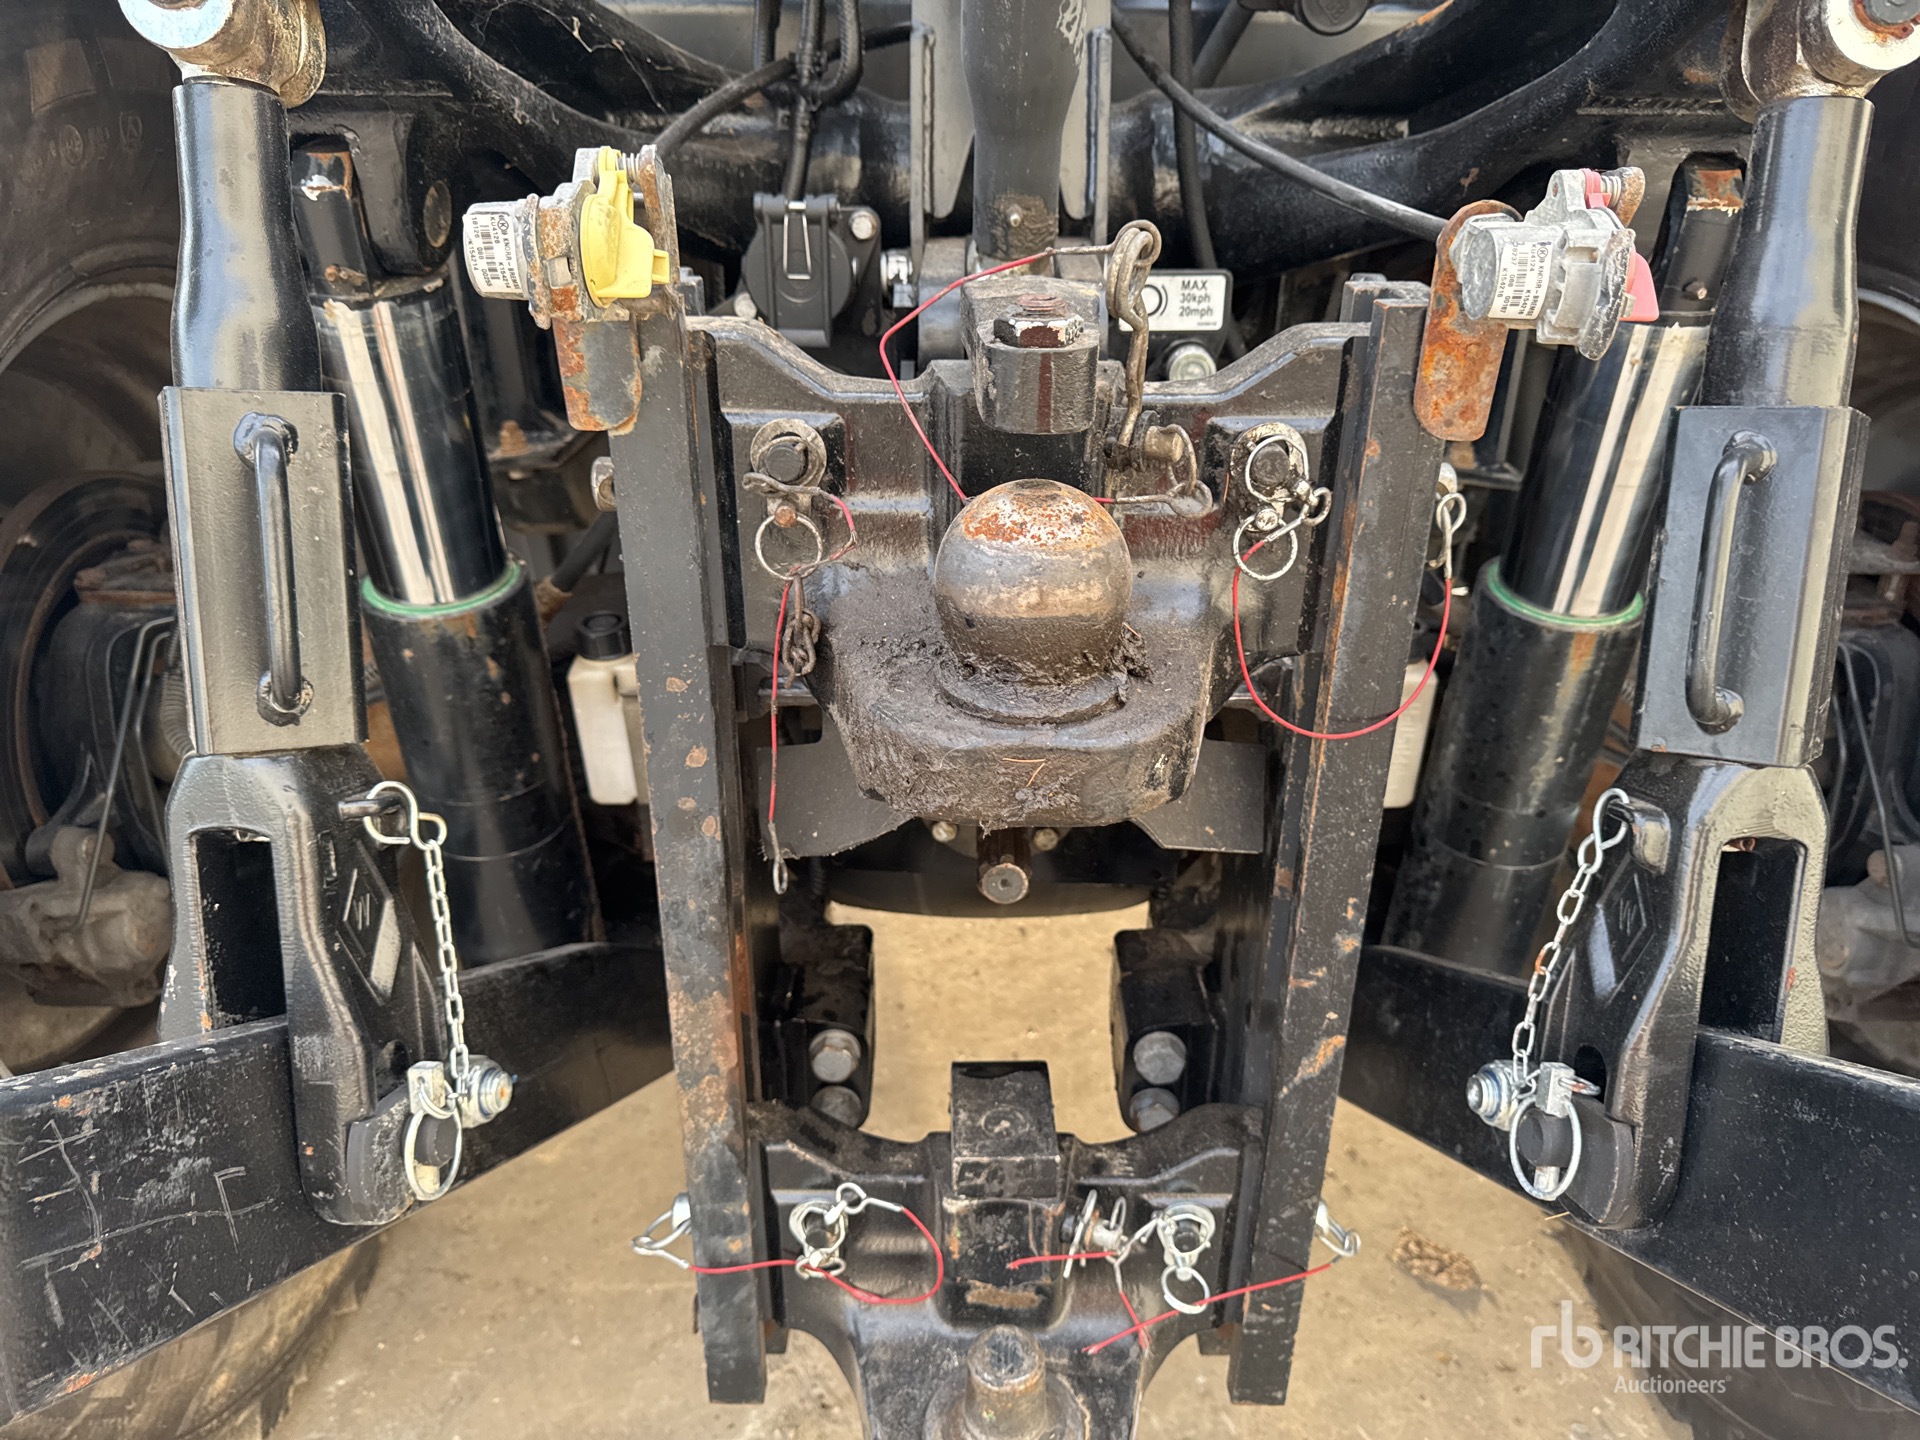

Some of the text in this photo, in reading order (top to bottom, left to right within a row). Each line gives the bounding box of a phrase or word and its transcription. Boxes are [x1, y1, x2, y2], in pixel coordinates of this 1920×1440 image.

[1181, 280, 1208, 291] MAX
[1180, 293, 1211, 305] 30kph
[1179, 306, 1213, 319] 20mph
